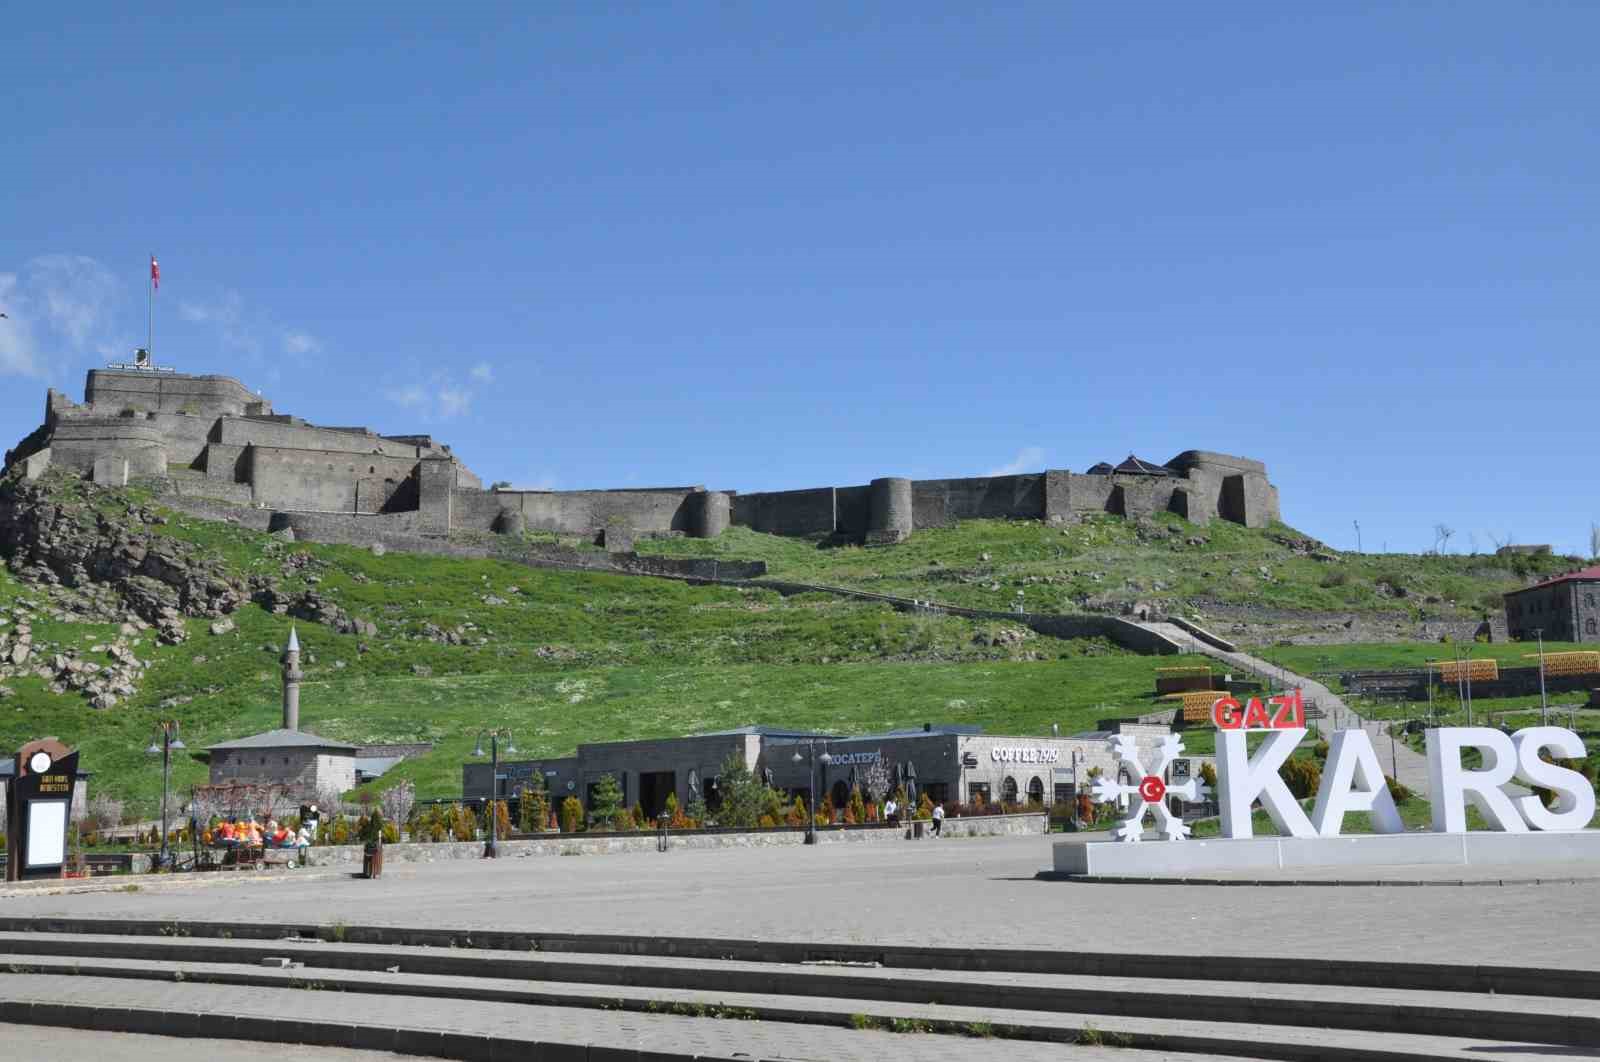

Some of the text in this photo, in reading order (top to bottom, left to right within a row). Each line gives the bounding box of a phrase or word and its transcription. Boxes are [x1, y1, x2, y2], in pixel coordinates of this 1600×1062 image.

[1212, 688, 1305, 728] GAZİ
[991, 747, 1037, 763] COFFEE
[1216, 726, 1597, 838] KARS
